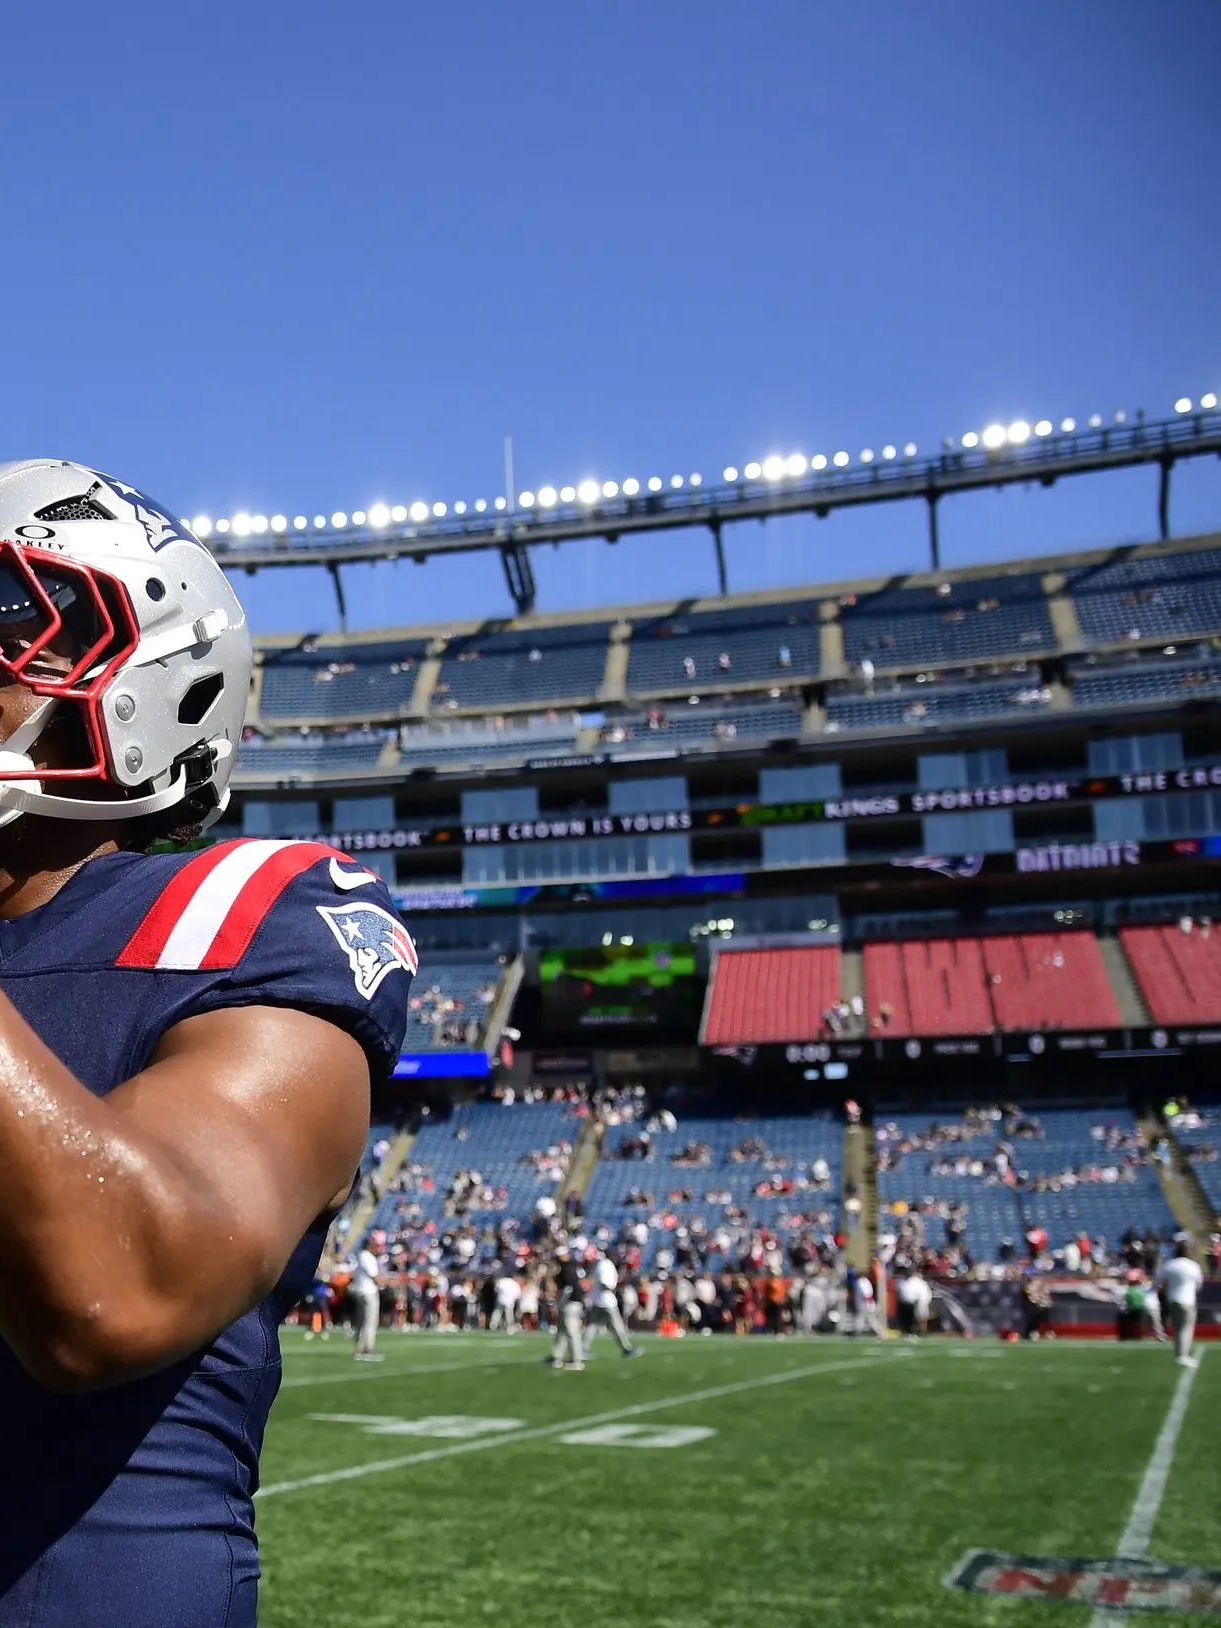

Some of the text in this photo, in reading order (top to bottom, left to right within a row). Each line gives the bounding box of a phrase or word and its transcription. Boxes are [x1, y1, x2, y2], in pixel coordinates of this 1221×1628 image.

[911, 782, 1069, 812] SPORTSBOOK
[1122, 773, 1166, 793] THE
[463, 825, 501, 843] THE
[507, 821, 586, 841] CROWN
[593, 818, 613, 835] IS
[620, 812, 692, 834] YOURS
